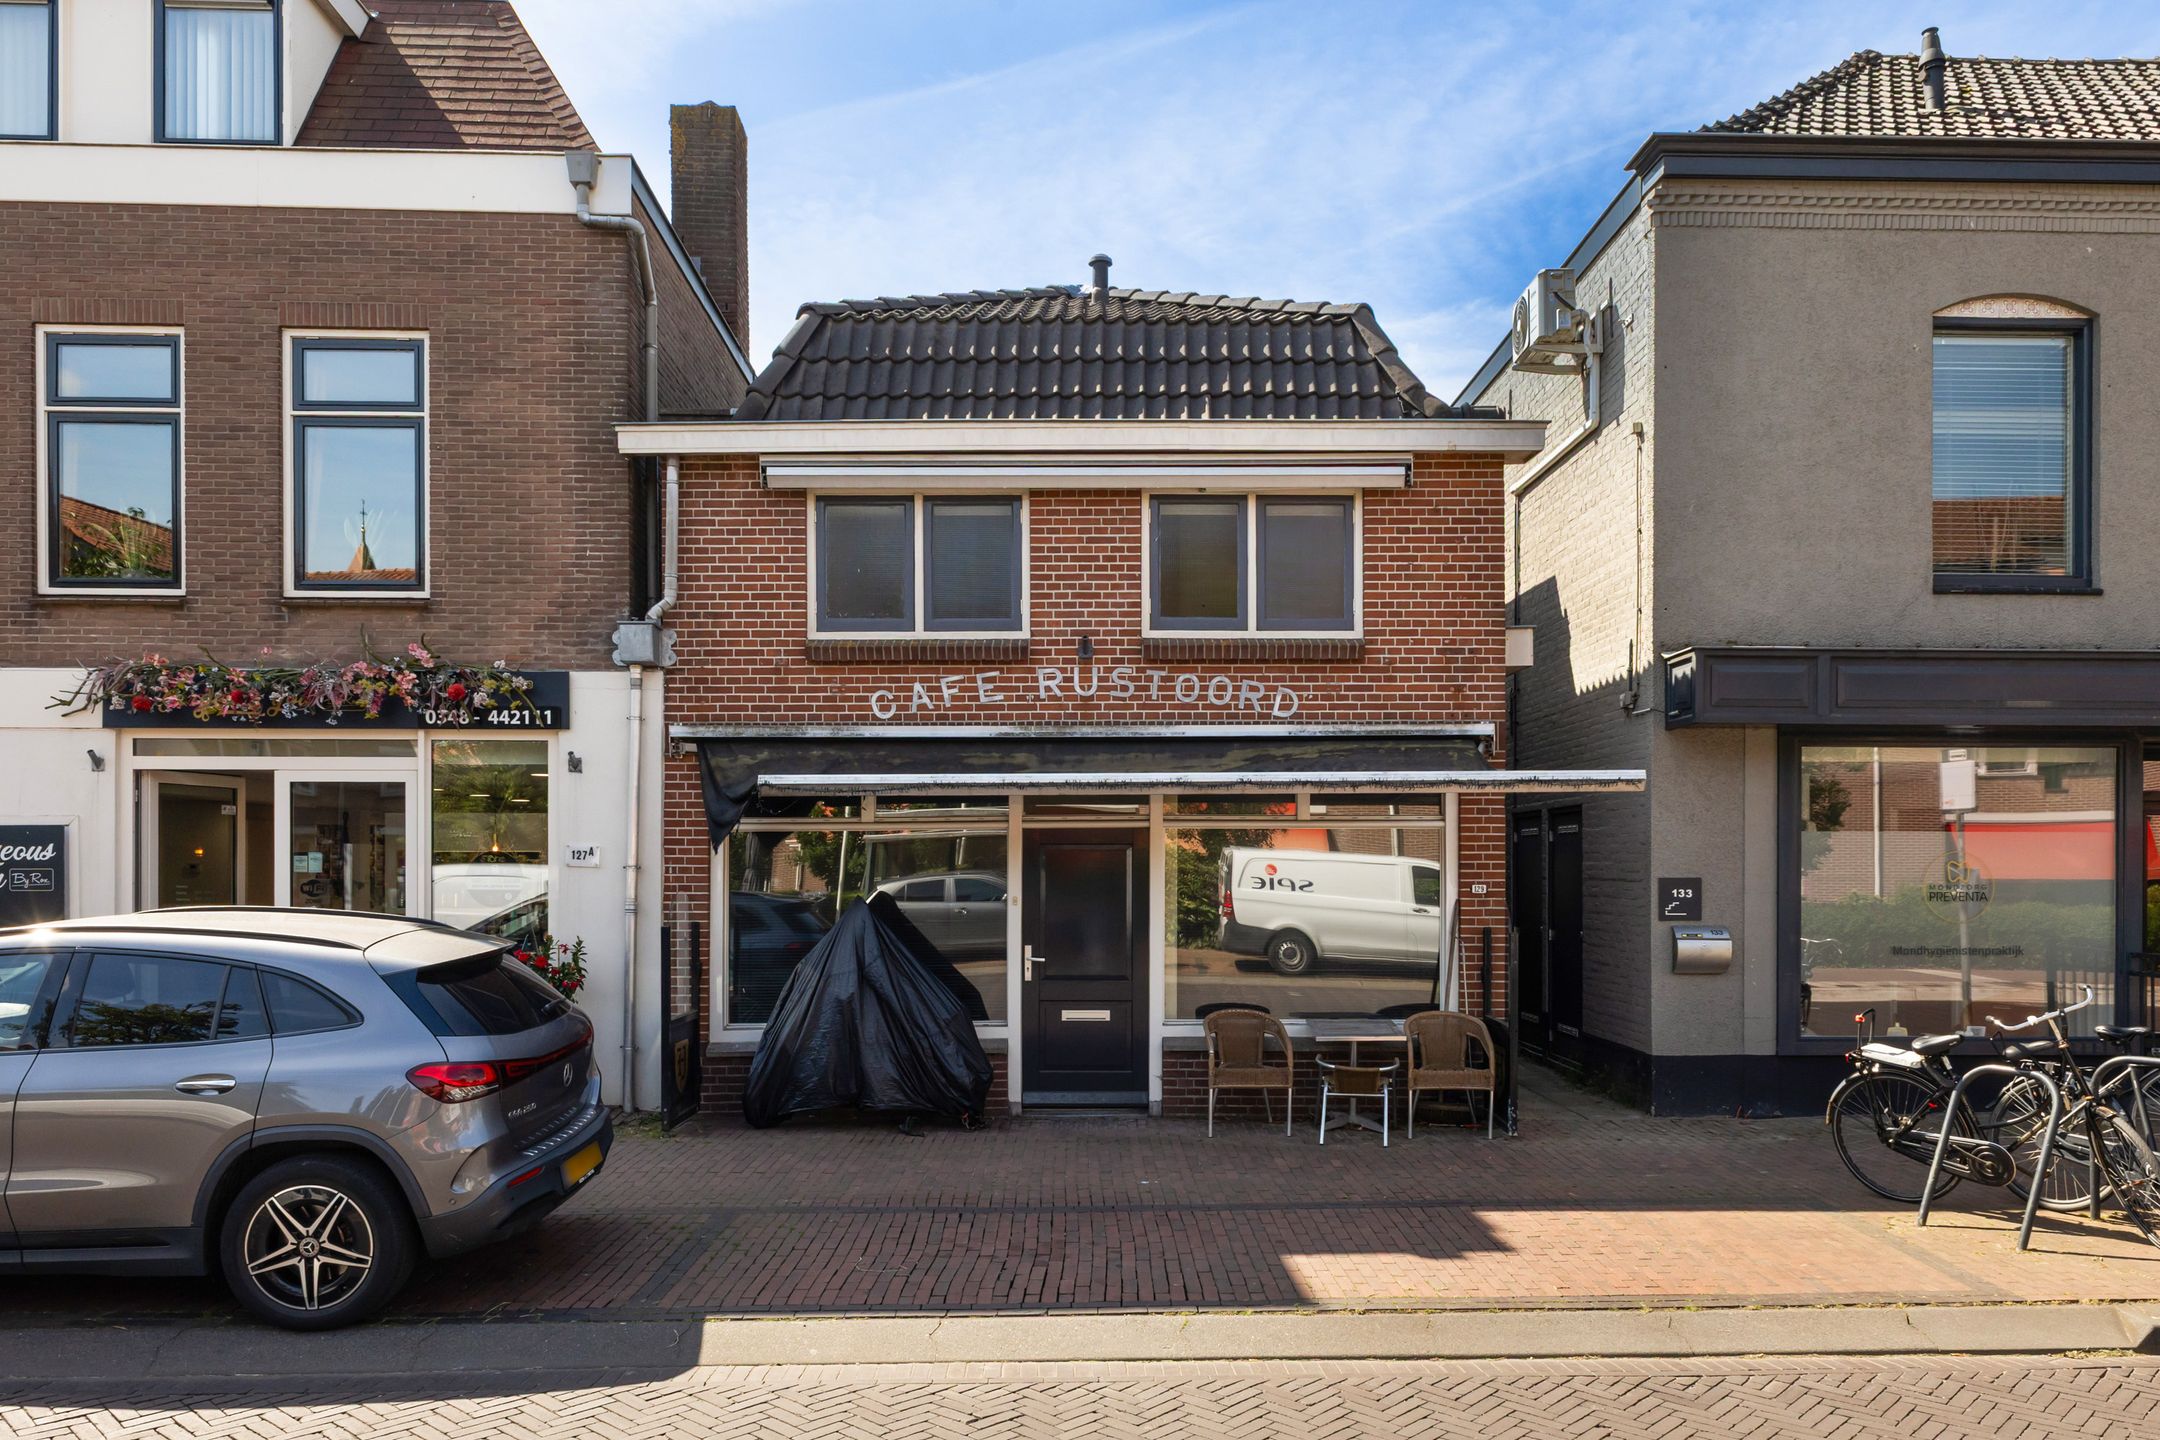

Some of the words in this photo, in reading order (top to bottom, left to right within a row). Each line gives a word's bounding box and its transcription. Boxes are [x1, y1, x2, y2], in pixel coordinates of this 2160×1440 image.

[871, 671, 1004, 720] CAFE
[487, 709, 552, 725] 442111
[0, 843, 57, 861] eous
[571, 846, 594, 860] 127A
[11, 872, 30, 888] By
[1671, 888, 1693, 899] 133
[1928, 891, 1989, 902] PREVENTA
